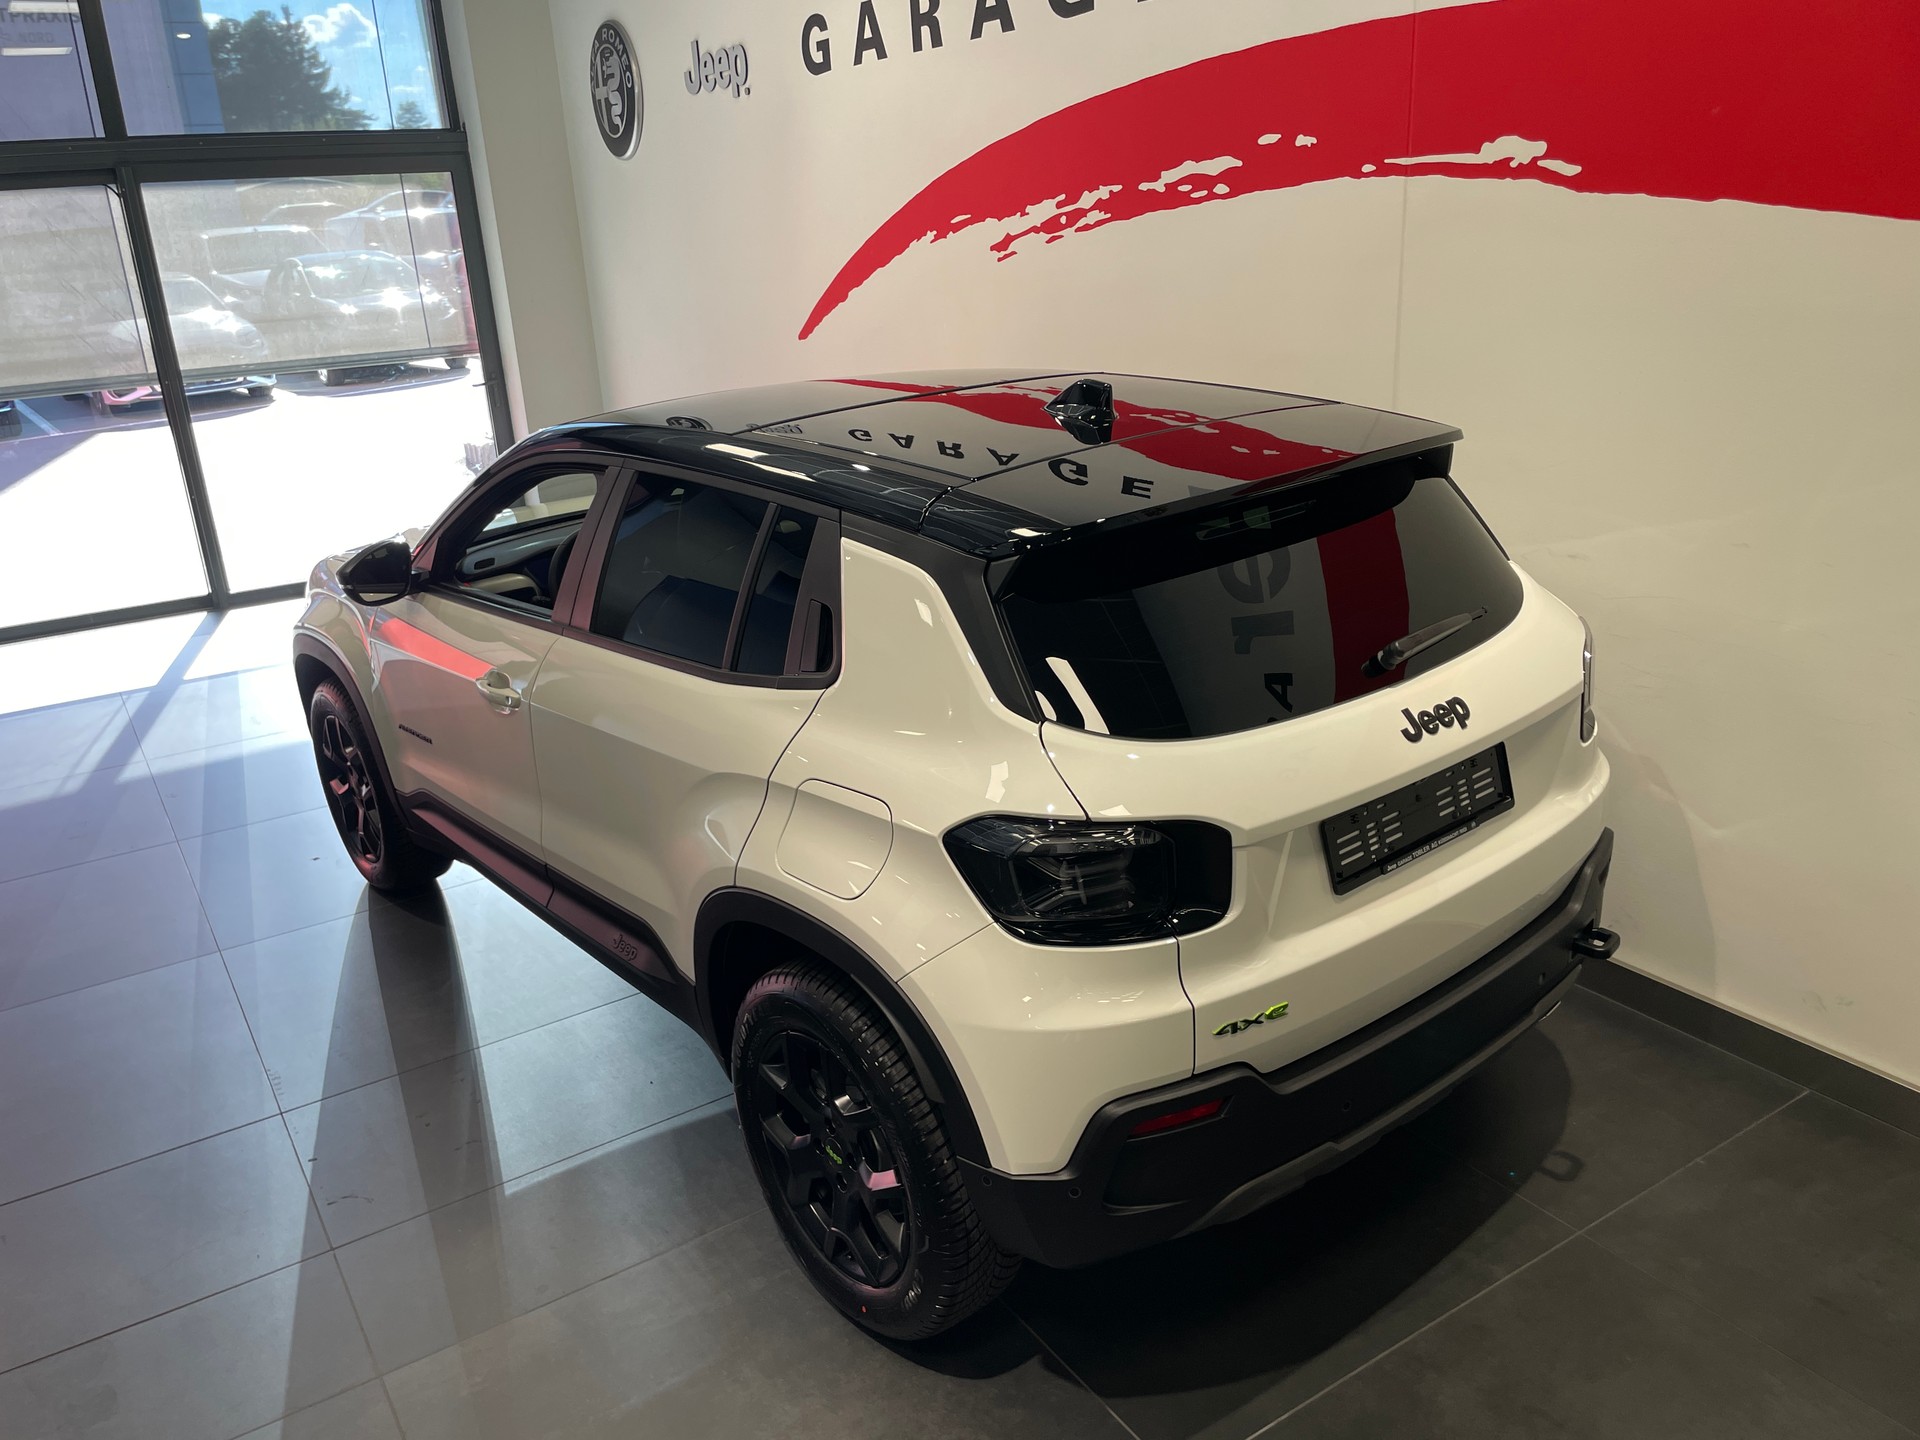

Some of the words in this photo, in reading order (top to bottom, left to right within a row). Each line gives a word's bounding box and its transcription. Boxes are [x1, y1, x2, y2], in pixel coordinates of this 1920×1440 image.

[601, 28, 632, 88] ROMEO
[1400, 696, 1471, 743] Jeep
[1412, 845, 1430, 858] TOBLER
[1431, 841, 1438, 849] AG
[613, 933, 638, 961] Jeep
